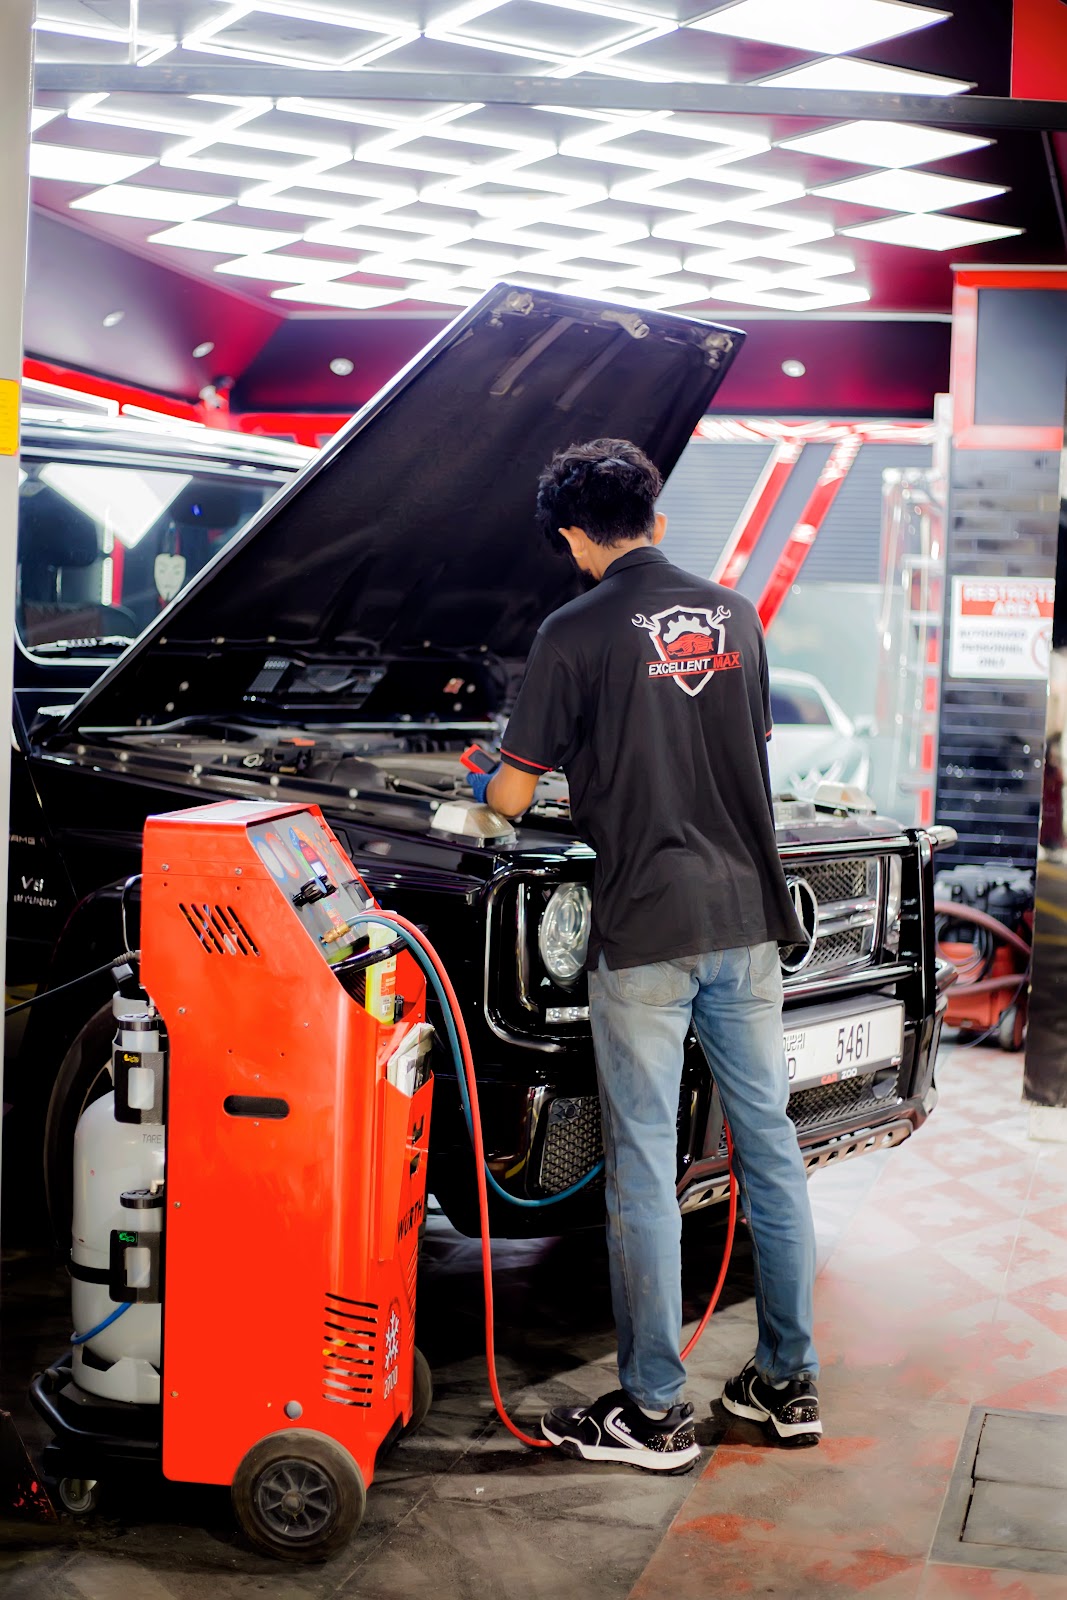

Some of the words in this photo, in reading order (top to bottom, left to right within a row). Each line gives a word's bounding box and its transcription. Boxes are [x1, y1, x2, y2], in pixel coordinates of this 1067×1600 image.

[963, 583, 1054, 603] RESTRICTE
[991, 599, 1041, 617] AREA
[648, 658, 711, 676] EXCELLENT
[713, 654, 740, 668] MAX
[21, 875, 44, 892] V8
[836, 1021, 871, 1065] 5461
[821, 1072, 839, 1085] CAR
[841, 1067, 858, 1080] ZOO
[142, 1133, 162, 1144] TARE
